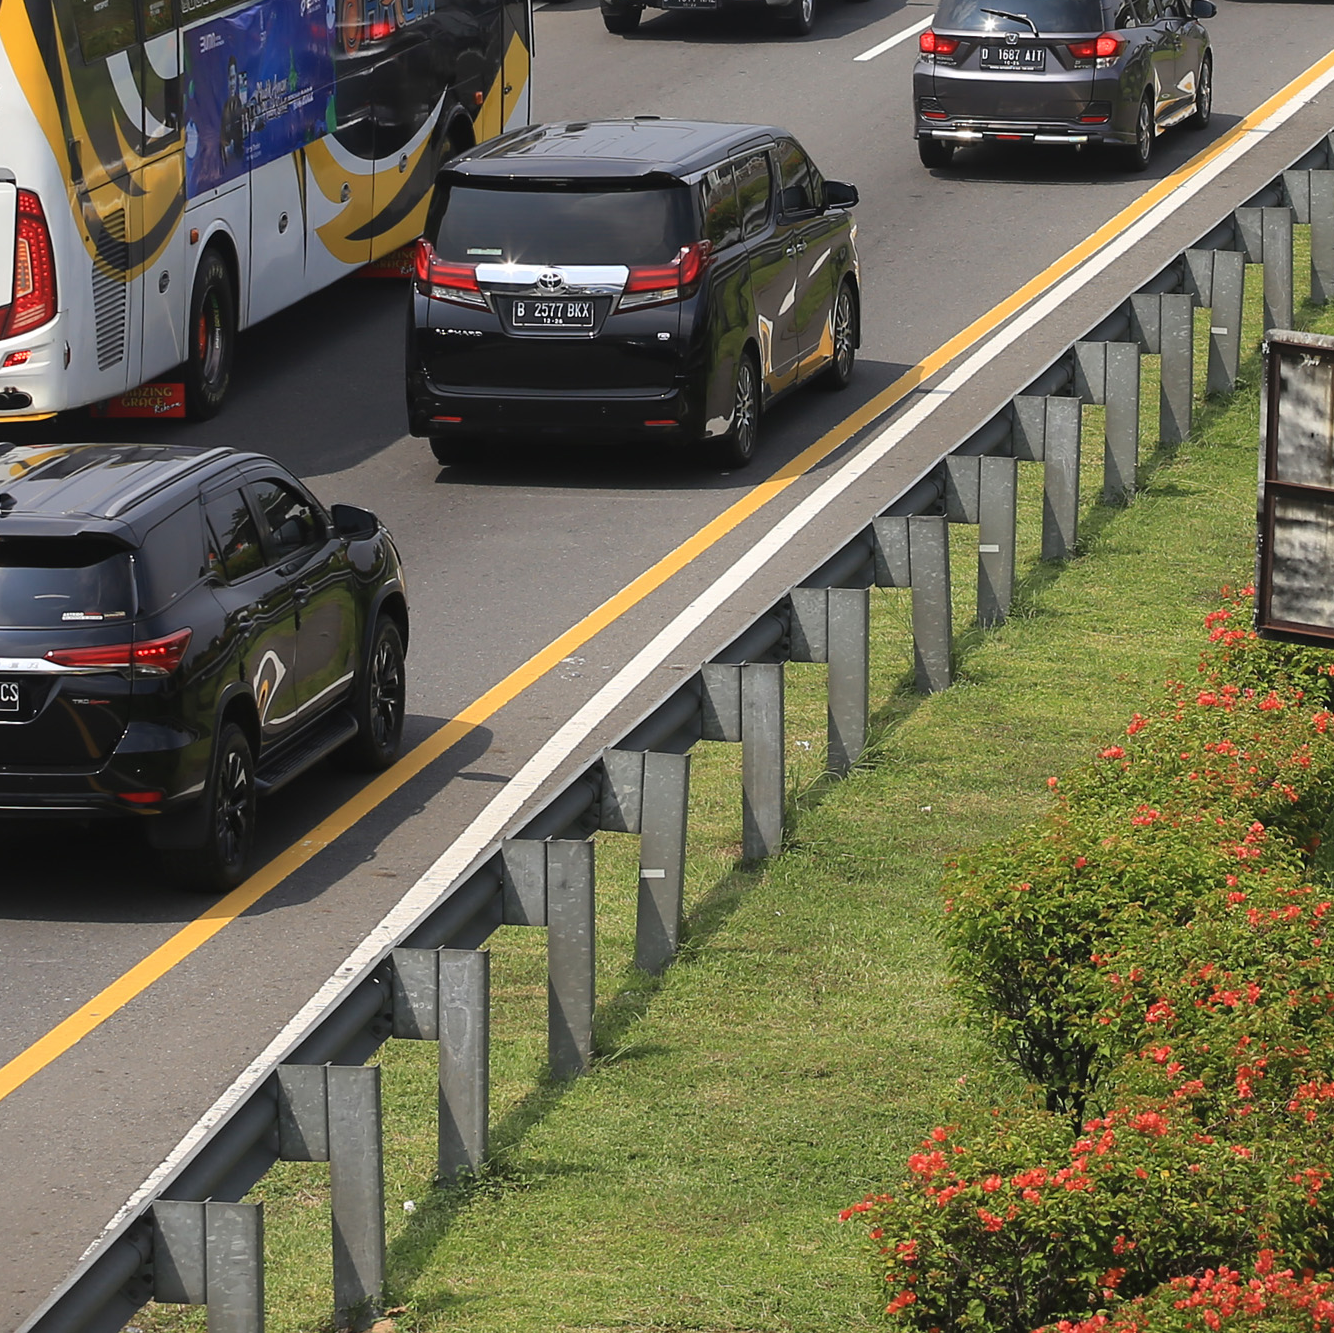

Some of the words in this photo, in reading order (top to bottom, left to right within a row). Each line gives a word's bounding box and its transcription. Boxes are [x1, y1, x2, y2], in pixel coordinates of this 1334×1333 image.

[982, 48, 989, 60] D
[998, 48, 1020, 61] 1687
[1024, 49, 1043, 62] AIT
[517, 302, 525, 316] B
[534, 302, 564, 317] 2577
[566, 303, 591, 317] BKX
[121, 396, 164, 408] GRACE
